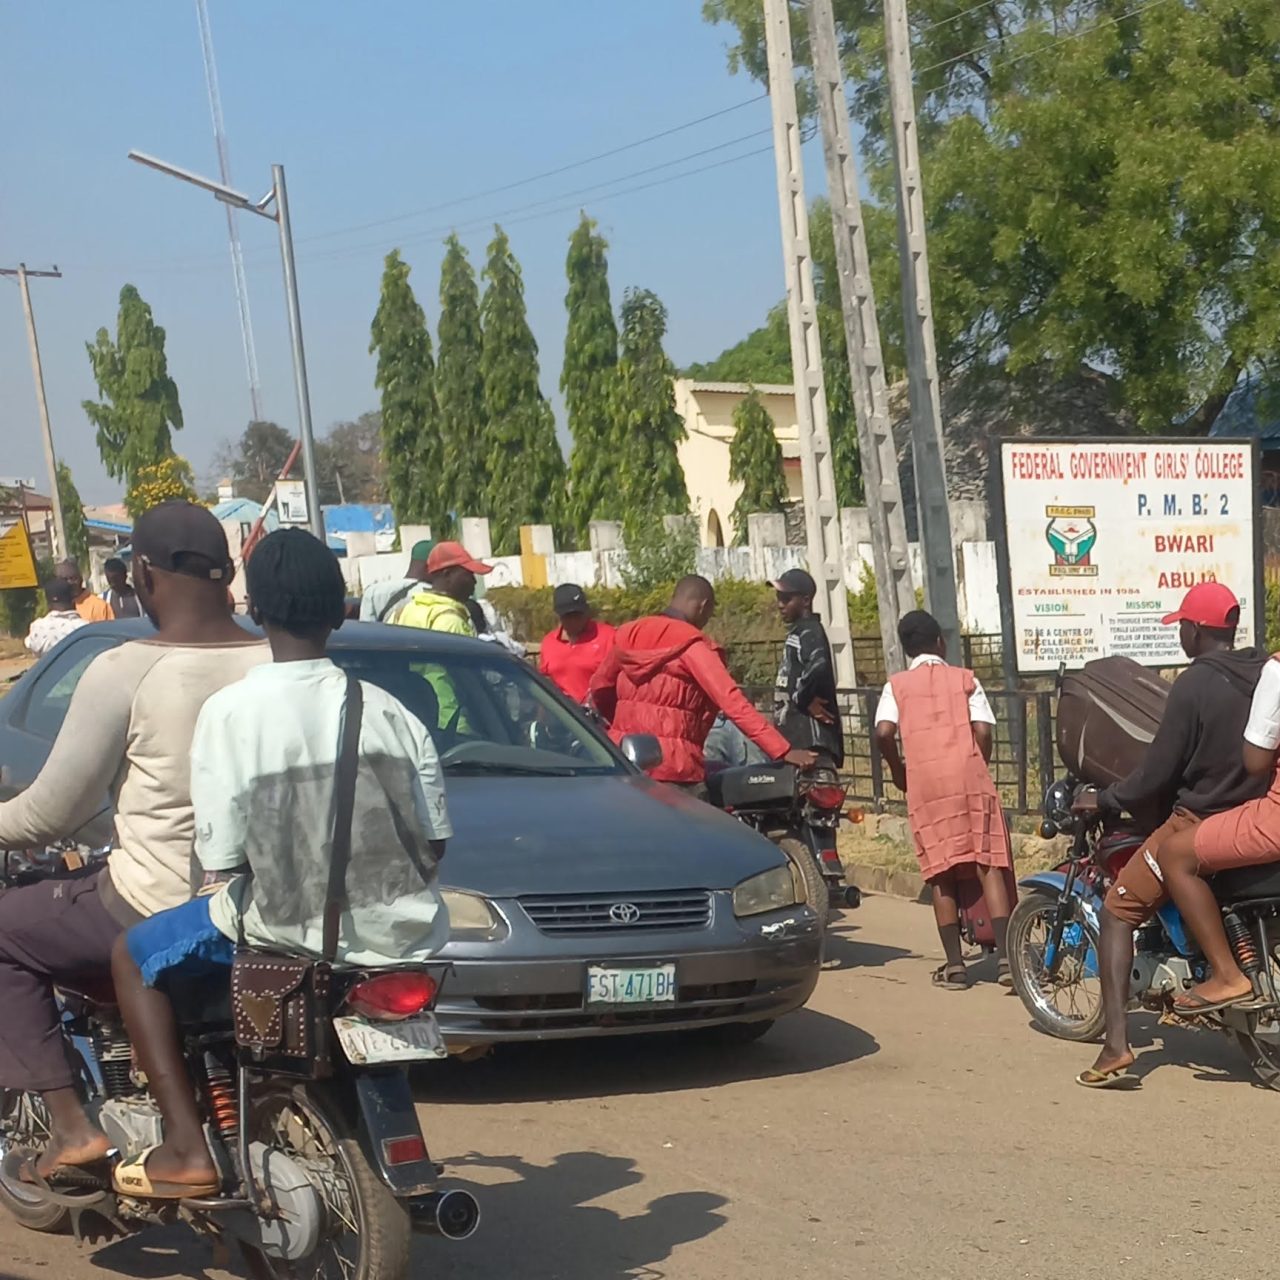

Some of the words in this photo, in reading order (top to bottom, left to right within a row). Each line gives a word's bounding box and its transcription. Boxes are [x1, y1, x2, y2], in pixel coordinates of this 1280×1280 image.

[1011, 452, 1064, 479] FEDERAL
[1070, 452, 1147, 479] GOVERNMENT
[1154, 452, 1189, 479] GIRLS'
[1195, 452, 1244, 479] COLLEGE
[1220, 494, 1229, 515] 2
[1155, 535, 1214, 553] BWARI
[1157, 572, 1218, 589] ABUJA
[1018, 588, 1096, 596] ESTABLISHED
[1034, 603, 1069, 612] VISION
[1125, 601, 1162, 610] MISSION
[1024, 629, 1033, 637] TO
[1053, 629, 1082, 637] CENTRE
[1083, 628, 1093, 636] OF
[1024, 638, 1082, 646] EXCELLENCE
[1040, 647, 1060, 655] CHILD
[1061, 646, 1099, 654] EDUCATION
